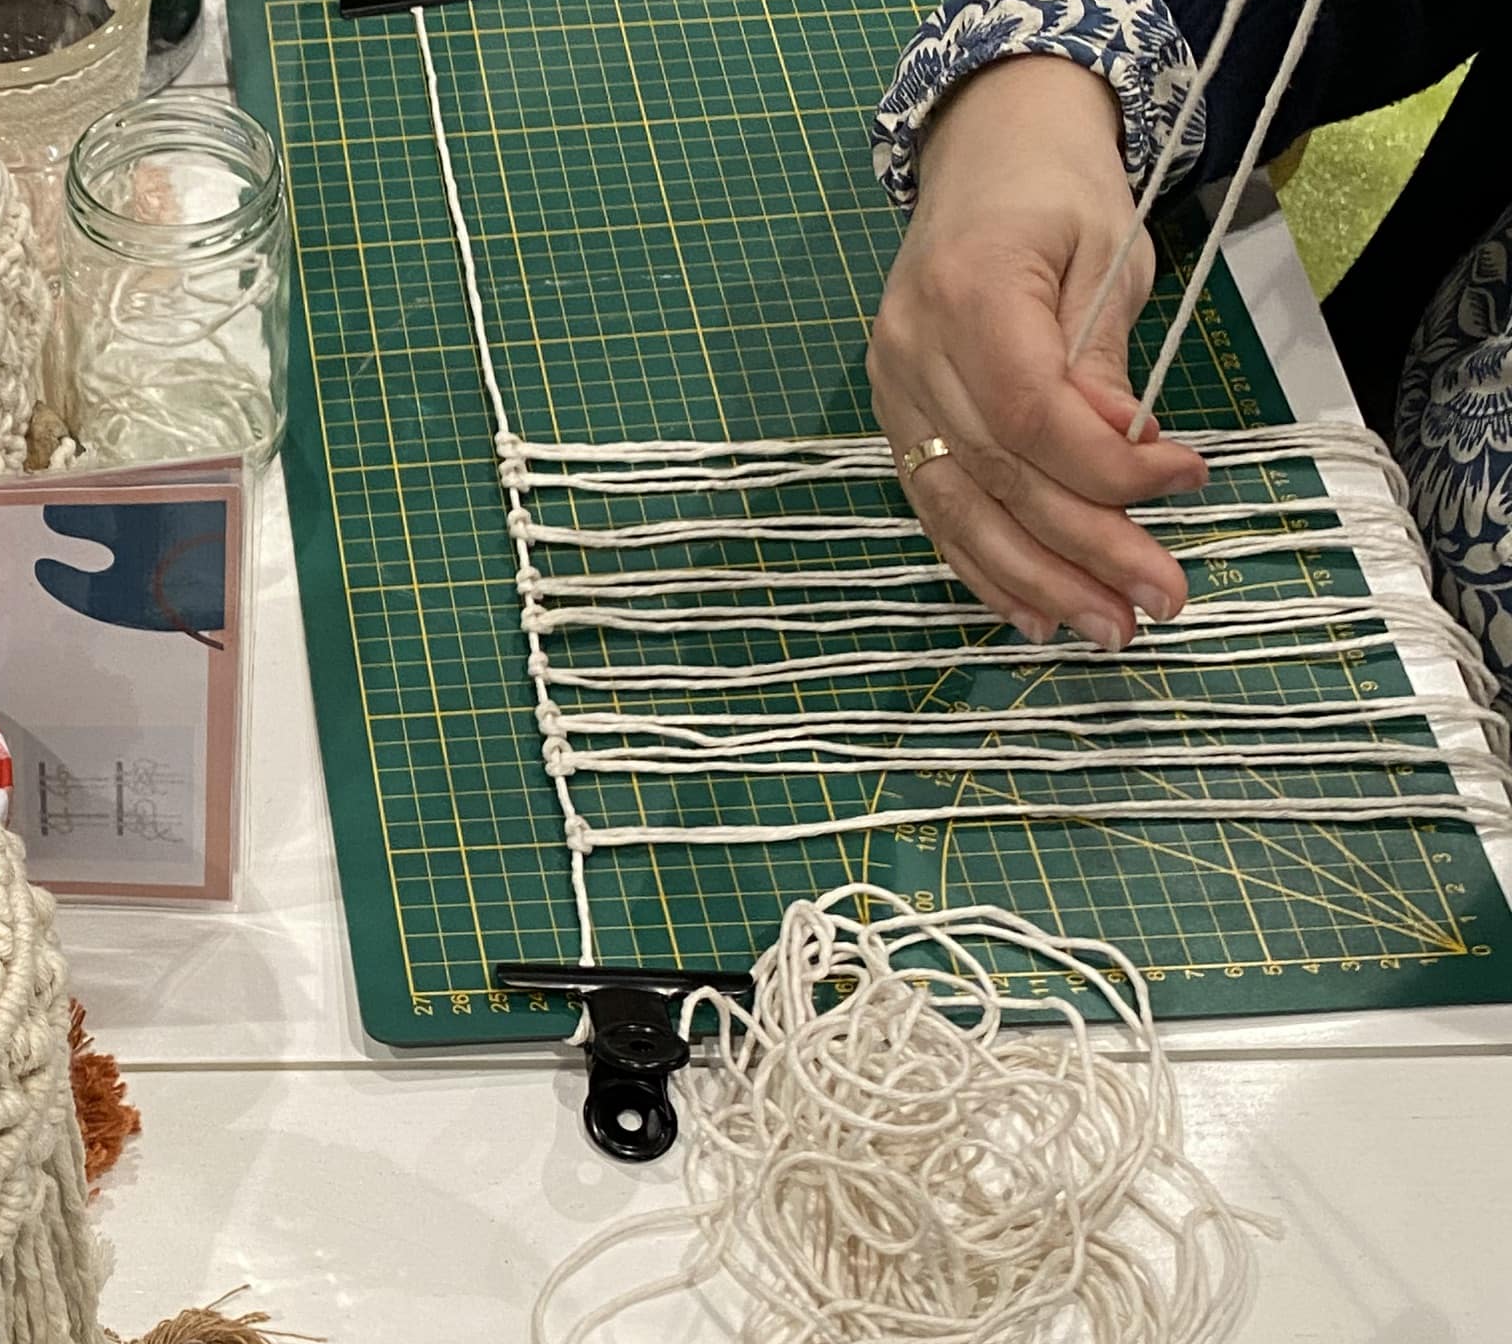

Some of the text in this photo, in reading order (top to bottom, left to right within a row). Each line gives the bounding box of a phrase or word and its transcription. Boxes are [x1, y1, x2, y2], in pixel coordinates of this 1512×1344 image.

[1207, 568, 1245, 588] 170
[1313, 569, 1335, 588] 13
[1346, 648, 1368, 667] 10
[1359, 680, 1379, 693] 9
[1431, 852, 1453, 864] 3
[1444, 883, 1467, 895] 2
[1471, 944, 1492, 956] 0
[895, 824, 916, 844] 70
[915, 824, 939, 853] 110
[412, 995, 434, 1017] 27
[450, 992, 472, 1015] 26
[489, 991, 511, 1013] 25
[1029, 977, 1050, 995] 11
[1065, 973, 1088, 994] 10
[1146, 969, 1167, 982] 8
[1184, 968, 1206, 981] 7
[1224, 965, 1245, 979] 6
[1263, 964, 1284, 977] 5
[1301, 962, 1321, 975] 4
[1339, 959, 1362, 972] 3
[1379, 957, 1402, 970] 2
